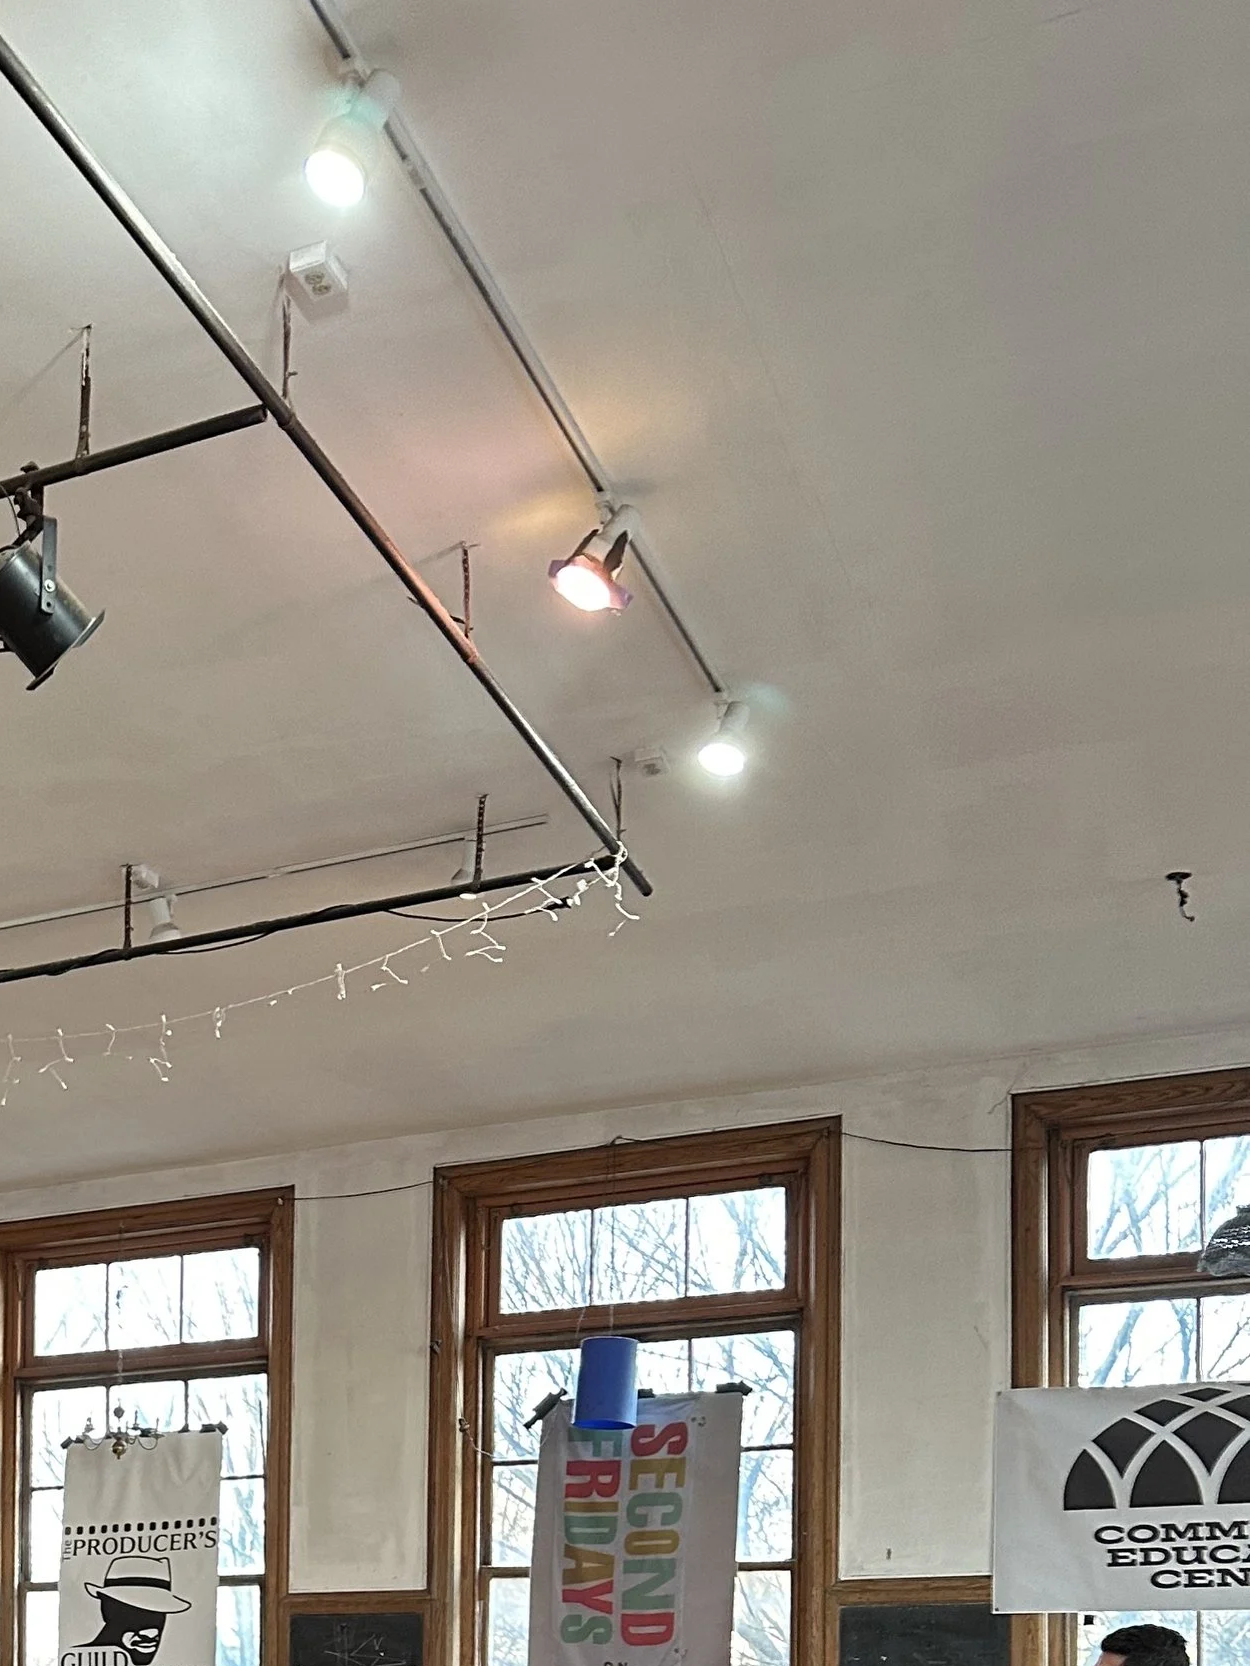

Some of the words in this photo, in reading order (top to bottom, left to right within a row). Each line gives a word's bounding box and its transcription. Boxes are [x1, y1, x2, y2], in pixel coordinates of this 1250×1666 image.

[72, 1530, 217, 1556] PRODUCER'S
[560, 1428, 623, 1646] FRIDAYS
[621, 1421, 689, 1647] SECOND
[1107, 1544, 1250, 1567] EDUC
